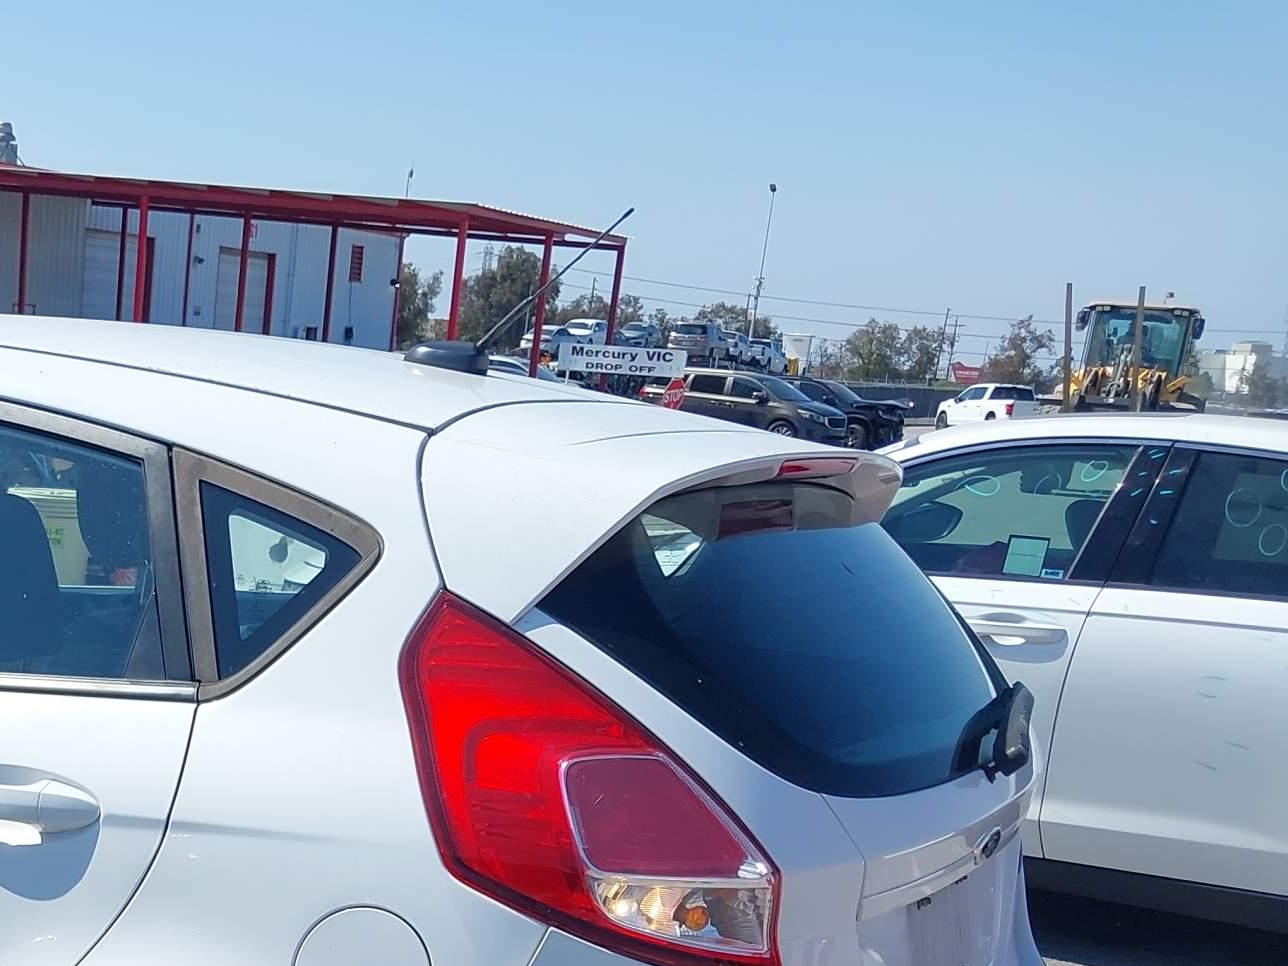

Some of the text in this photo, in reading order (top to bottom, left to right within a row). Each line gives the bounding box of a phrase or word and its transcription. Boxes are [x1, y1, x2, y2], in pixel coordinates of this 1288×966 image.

[571, 346, 674, 362] Mercury VIC
[585, 361, 656, 373] DROP OFF
[664, 388, 683, 403] STOP
